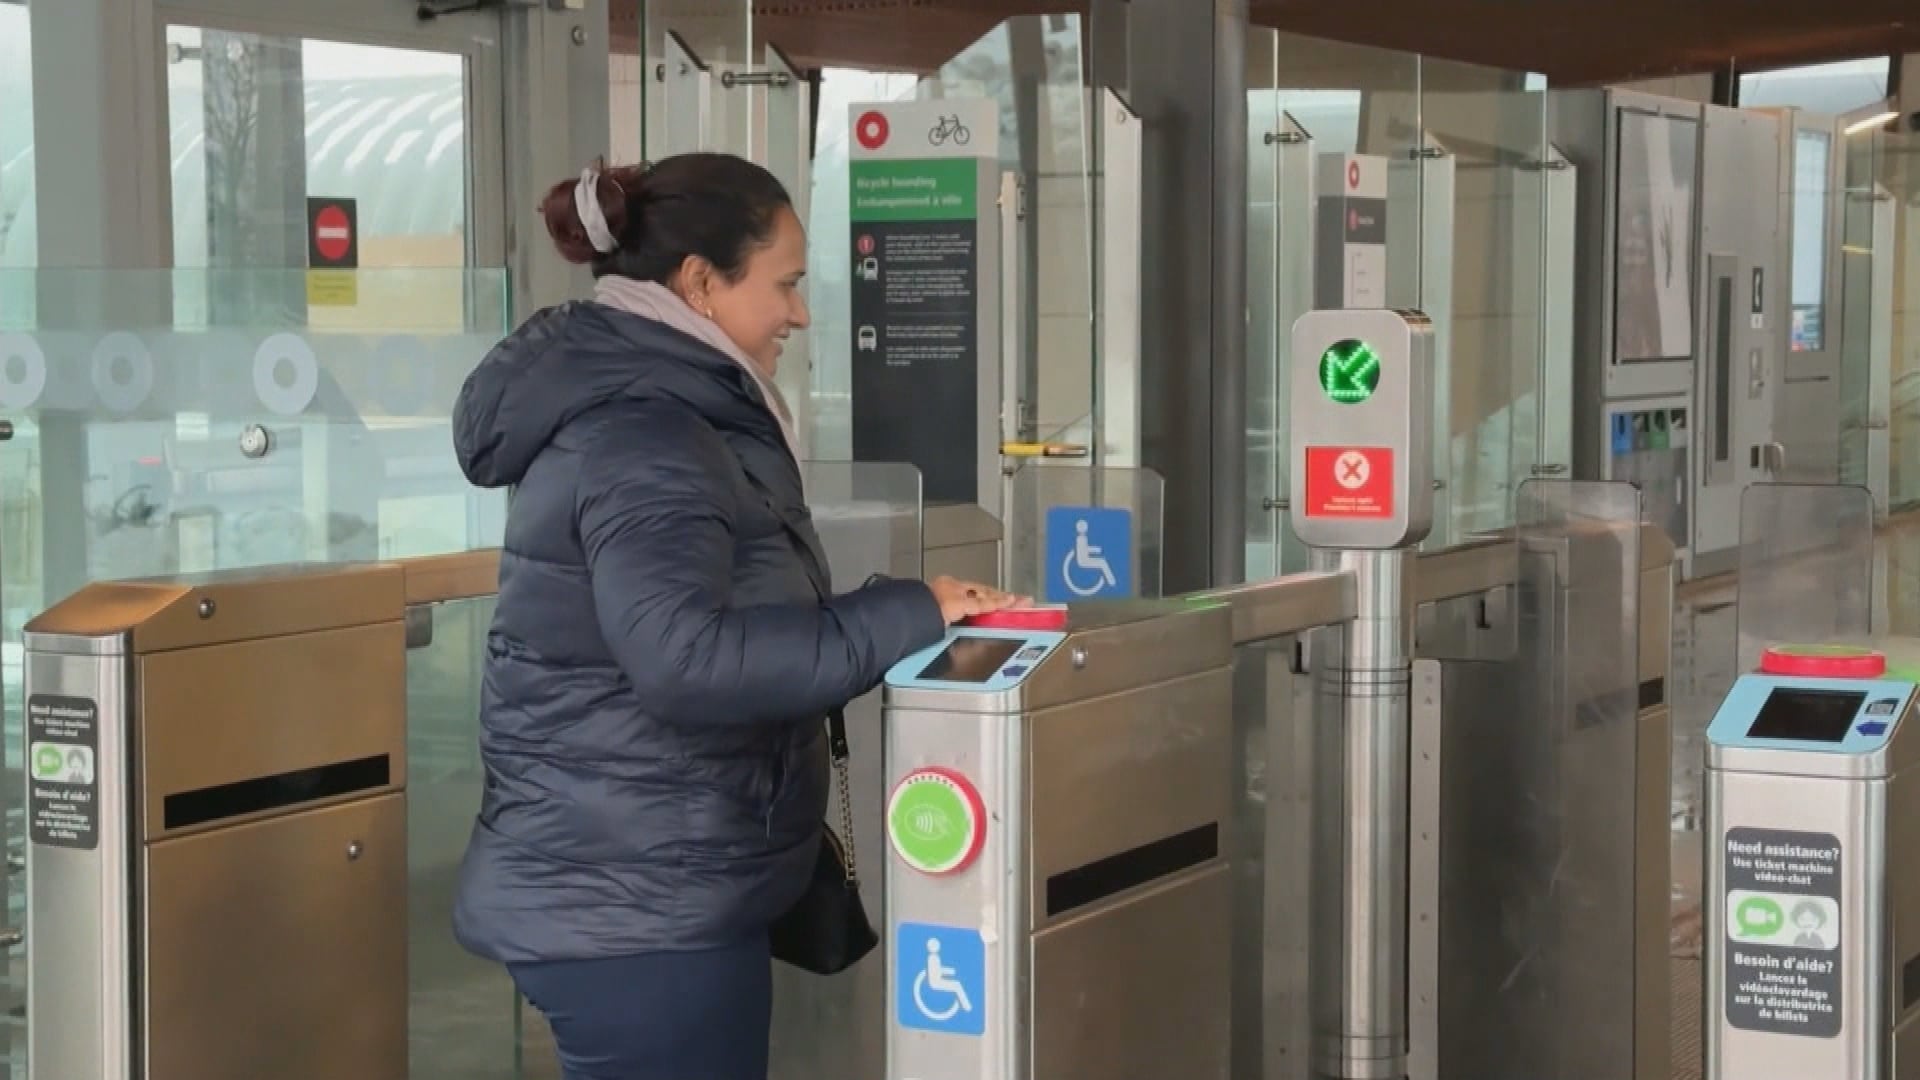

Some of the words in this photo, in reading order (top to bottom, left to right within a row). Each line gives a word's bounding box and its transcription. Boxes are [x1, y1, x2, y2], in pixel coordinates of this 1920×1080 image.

[1728, 840, 1762, 855] Need
[1764, 844, 1839, 861] assistance?
[1733, 857, 1752, 868] Use
[1755, 858, 1785, 871] ticket
[1787, 862, 1834, 875] machine
[1754, 871, 1811, 886] video-chat
[1735, 952, 1779, 968] Besoin
[1783, 956, 1834, 974] d'aide?
[1760, 971, 1795, 985] Lancez
[1735, 995, 1751, 1004] sur
[1766, 997, 1833, 1013] distributrice
[1759, 1008, 1773, 1019] de
[1775, 1009, 1809, 1022] billets
